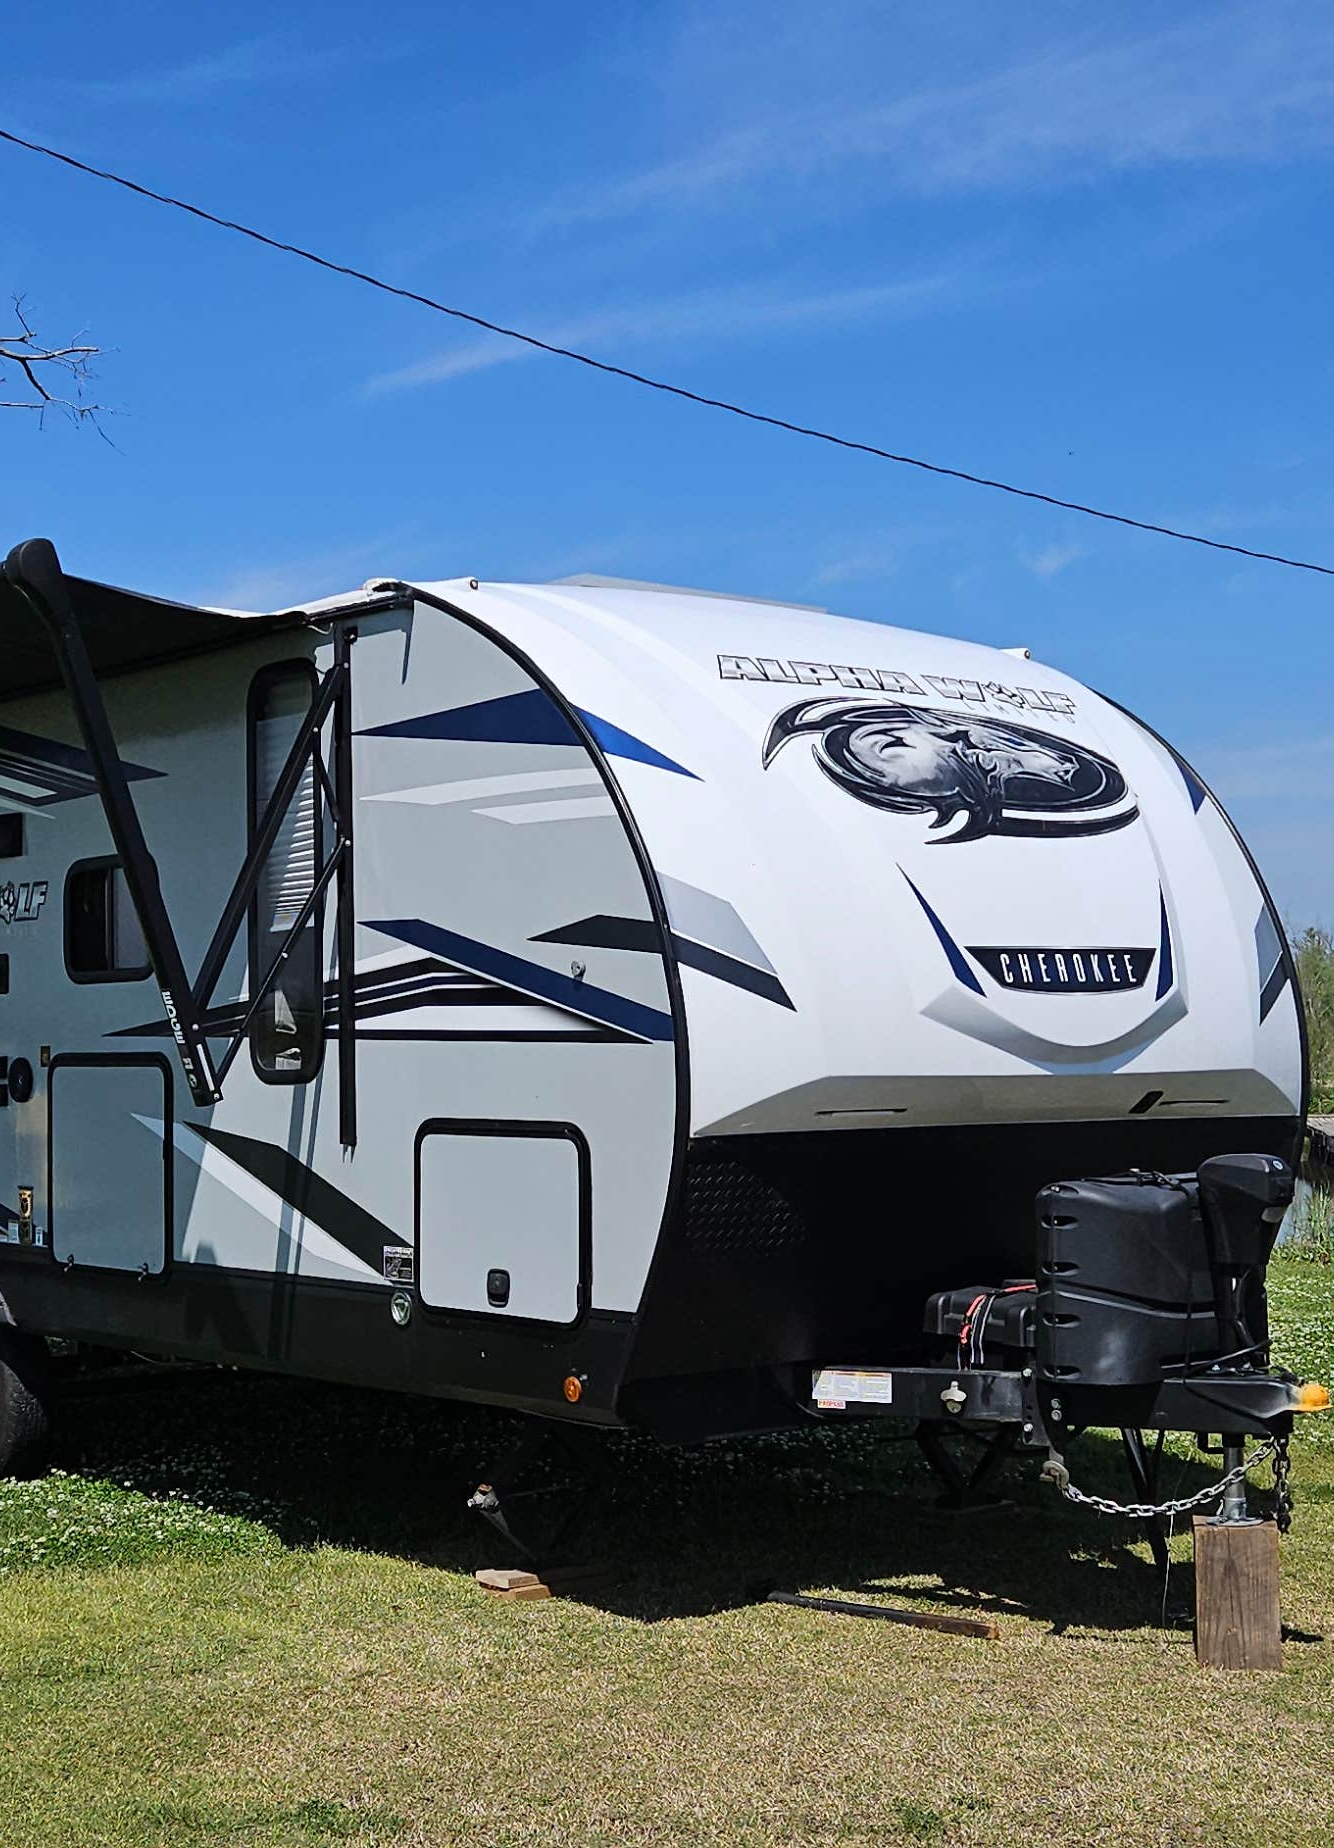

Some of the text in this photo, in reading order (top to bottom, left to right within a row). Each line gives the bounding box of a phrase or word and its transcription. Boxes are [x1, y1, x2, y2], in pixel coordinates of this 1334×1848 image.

[717, 654, 928, 696] ALPHA
[999, 952, 1137, 983] CHEROKEE
[161, 990, 186, 1044] EDGE
